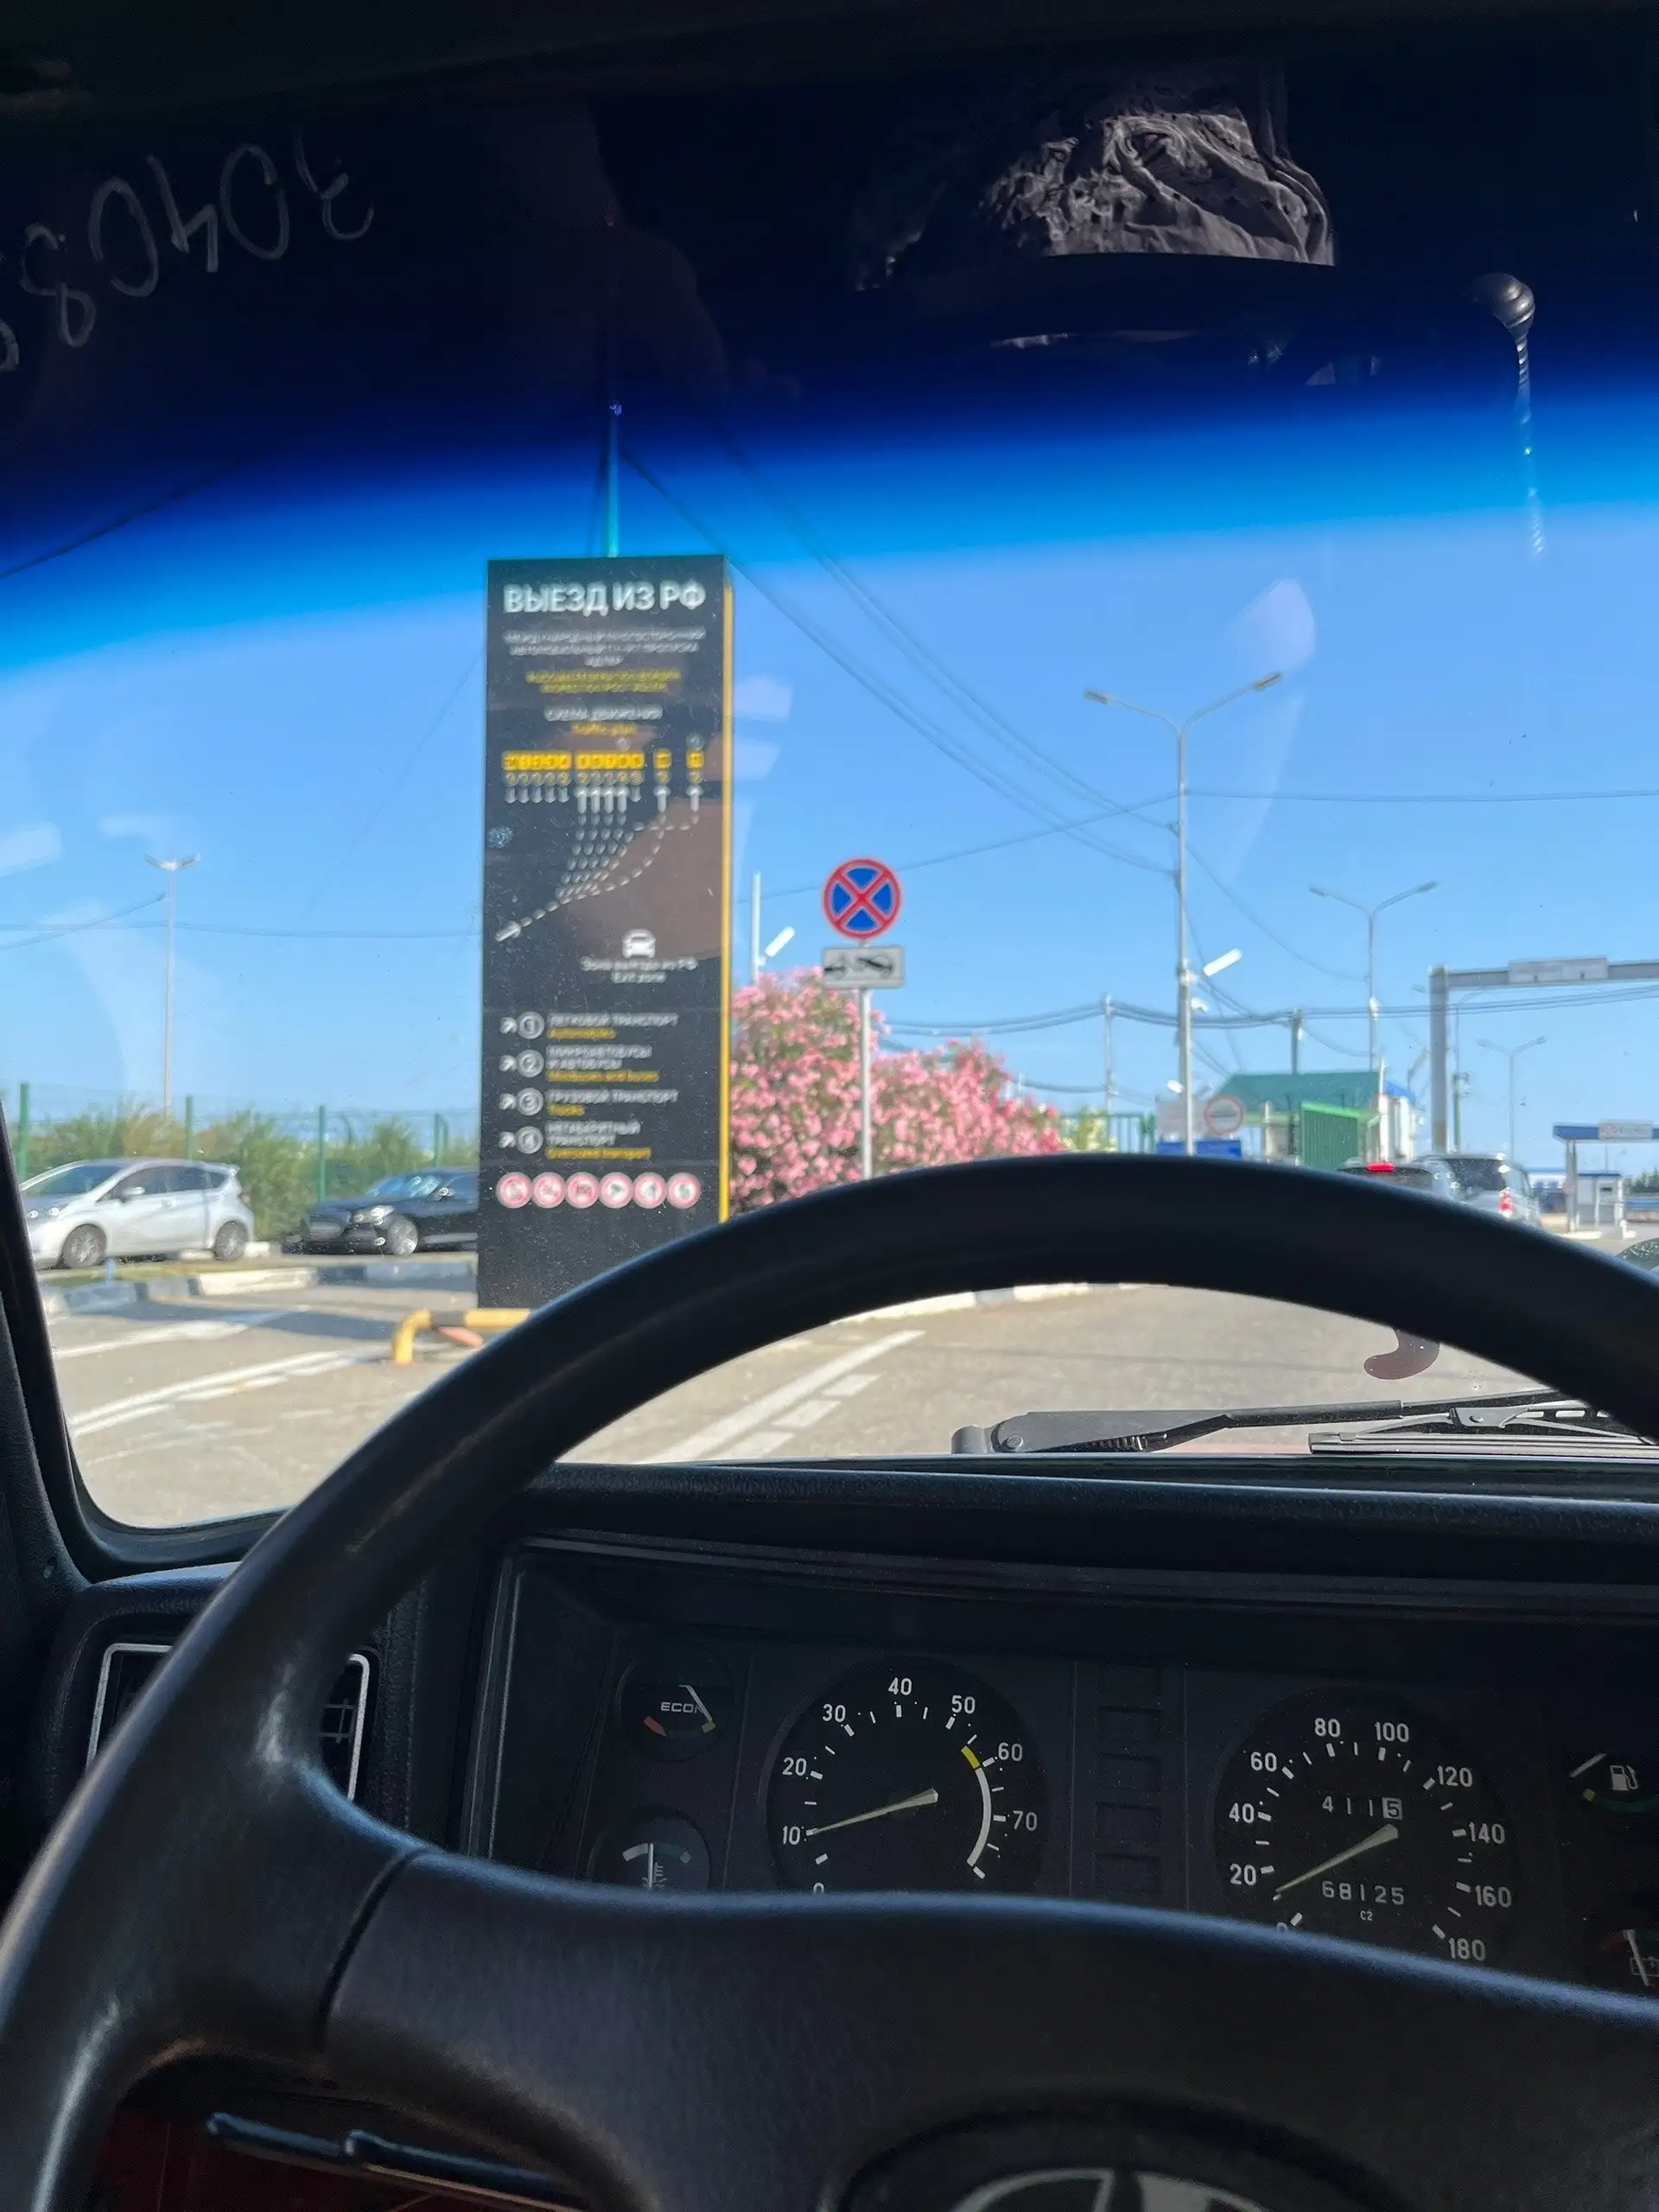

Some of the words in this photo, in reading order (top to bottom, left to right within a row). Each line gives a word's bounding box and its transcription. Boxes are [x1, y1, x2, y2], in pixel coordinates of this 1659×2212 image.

[503, 583, 609, 617] ВЫЕЗД
[612, 582, 655, 611] ИЗ
[659, 579, 706, 610] РФ
[888, 1677, 912, 1696] 40
[823, 1704, 847, 1723] 30
[951, 1695, 976, 1714] 50
[1314, 1718, 1341, 1738] 80
[1375, 1722, 1409, 1742] 100
[998, 1742, 1023, 1762] 60
[1250, 1751, 1278, 1771] 60
[782, 1758, 807, 1777] 20
[1437, 1767, 1472, 1787] 120
[1013, 1811, 1038, 1831] 70
[1229, 1803, 1255, 1823] 40
[782, 1826, 801, 1846] 10
[1469, 1823, 1505, 1845] 140
[1230, 1864, 1257, 1885] 20
[1321, 1880, 1405, 1905] 68125
[1475, 1886, 1511, 1907] 160
[1448, 1938, 1486, 1961] 180
